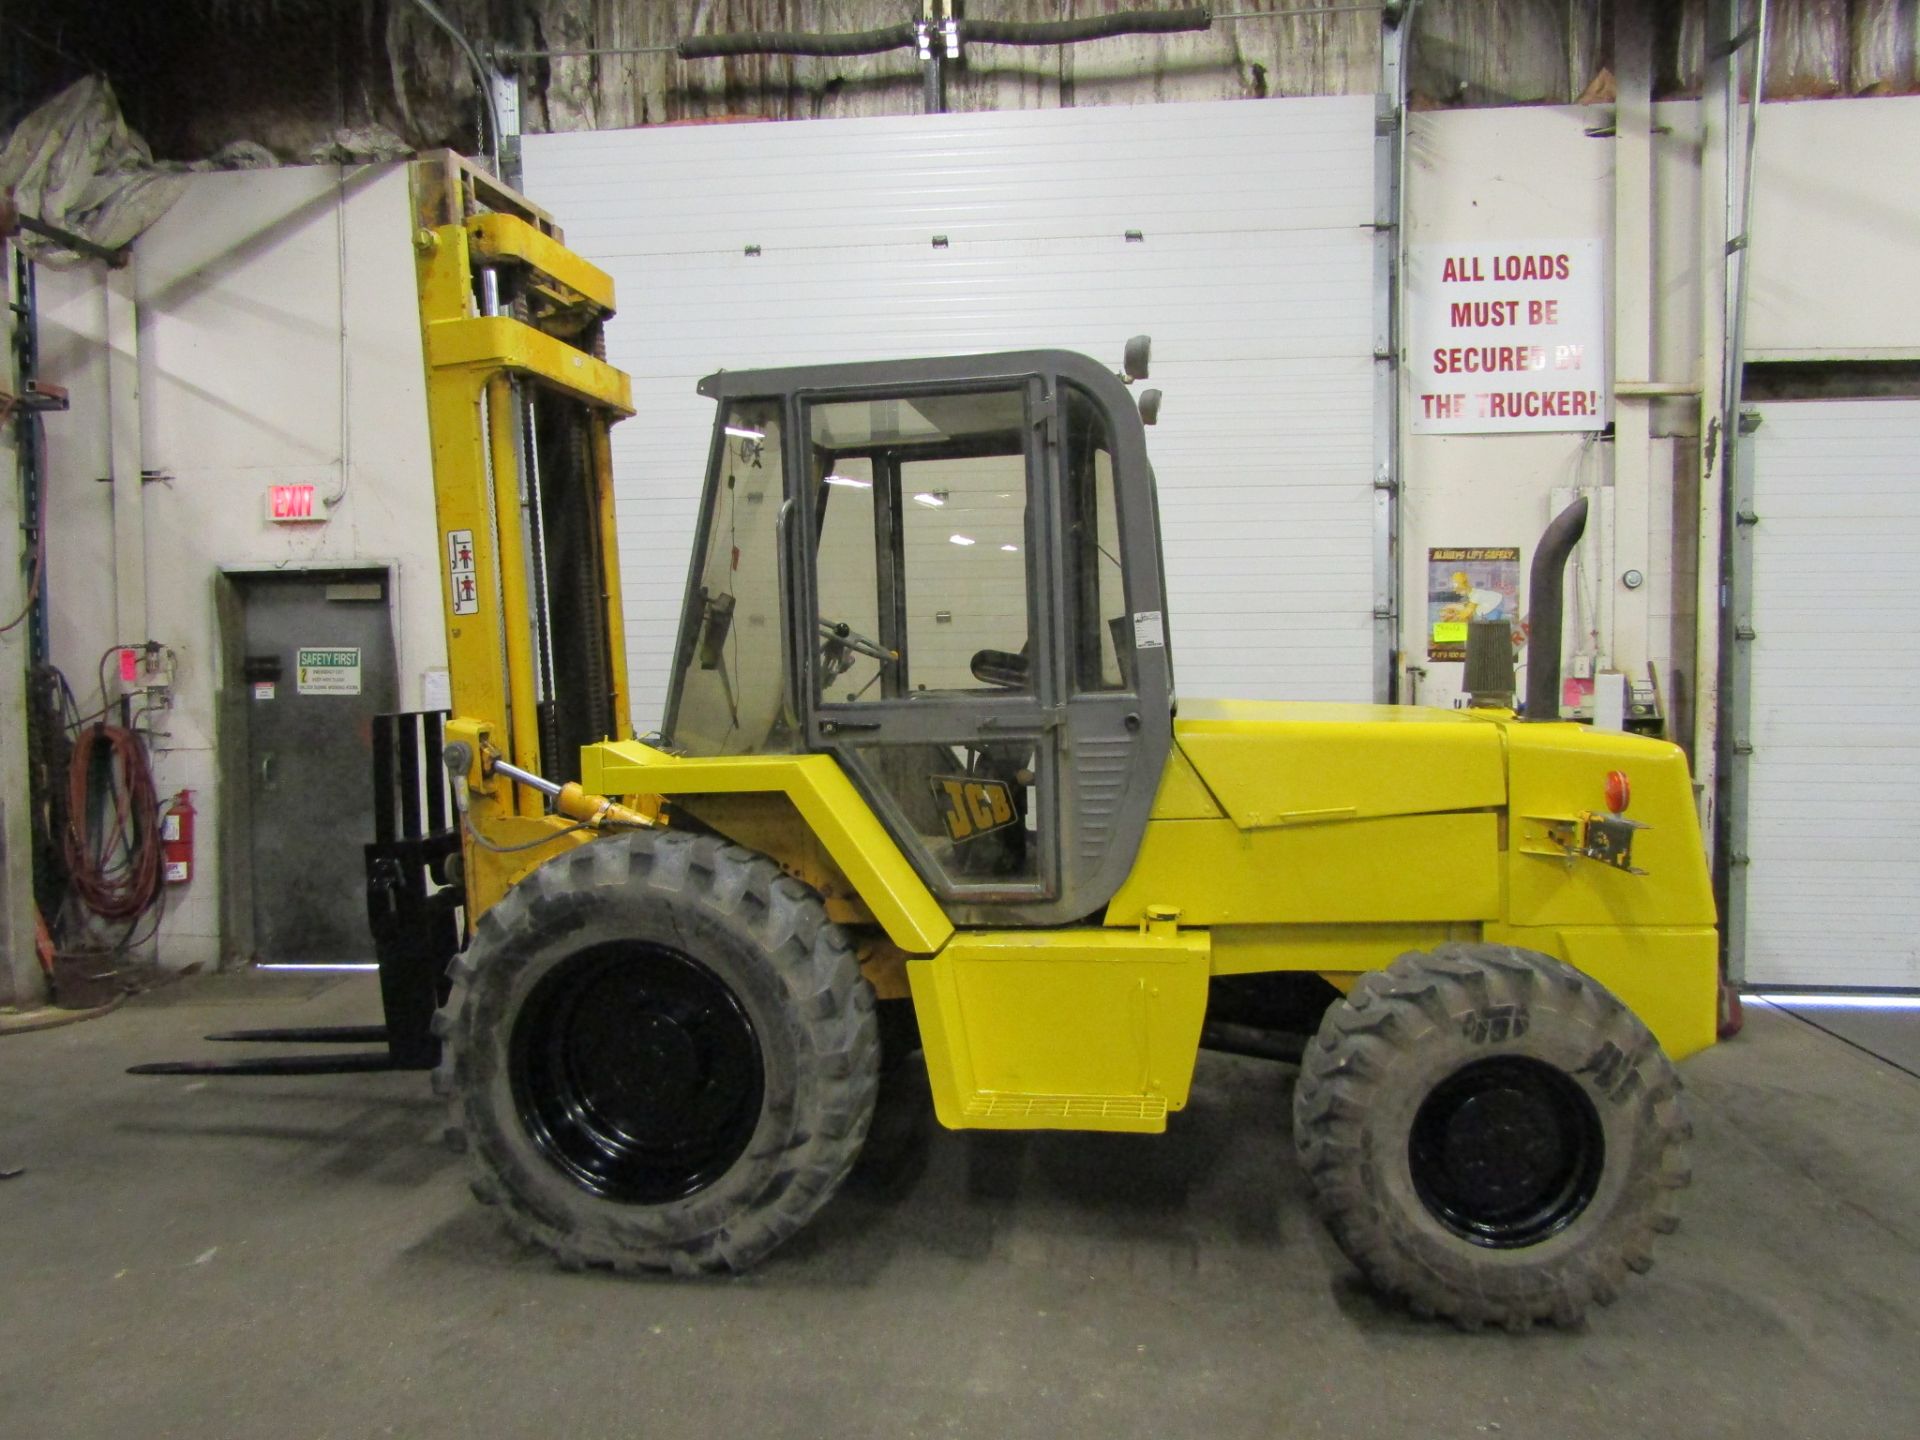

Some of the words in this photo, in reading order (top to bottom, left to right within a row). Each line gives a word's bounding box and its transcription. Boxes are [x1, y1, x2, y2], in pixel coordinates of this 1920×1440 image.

[1442, 257, 1484, 282] ALL
[1493, 254, 1570, 281] LOADS
[1451, 300, 1519, 327] MUST
[1528, 299, 1558, 325] BE
[1433, 346, 1546, 373] SECURED
[1420, 394, 1466, 419] THE
[1474, 390, 1597, 418] TRUCKER!
[274, 485, 314, 517] EXIT
[1433, 550, 1466, 560] ALWAYS
[1466, 550, 1484, 560] LIFT
[301, 653, 332, 665] SAFETY
[333, 653, 356, 665] FIRST
[943, 781, 1011, 839] JCB
